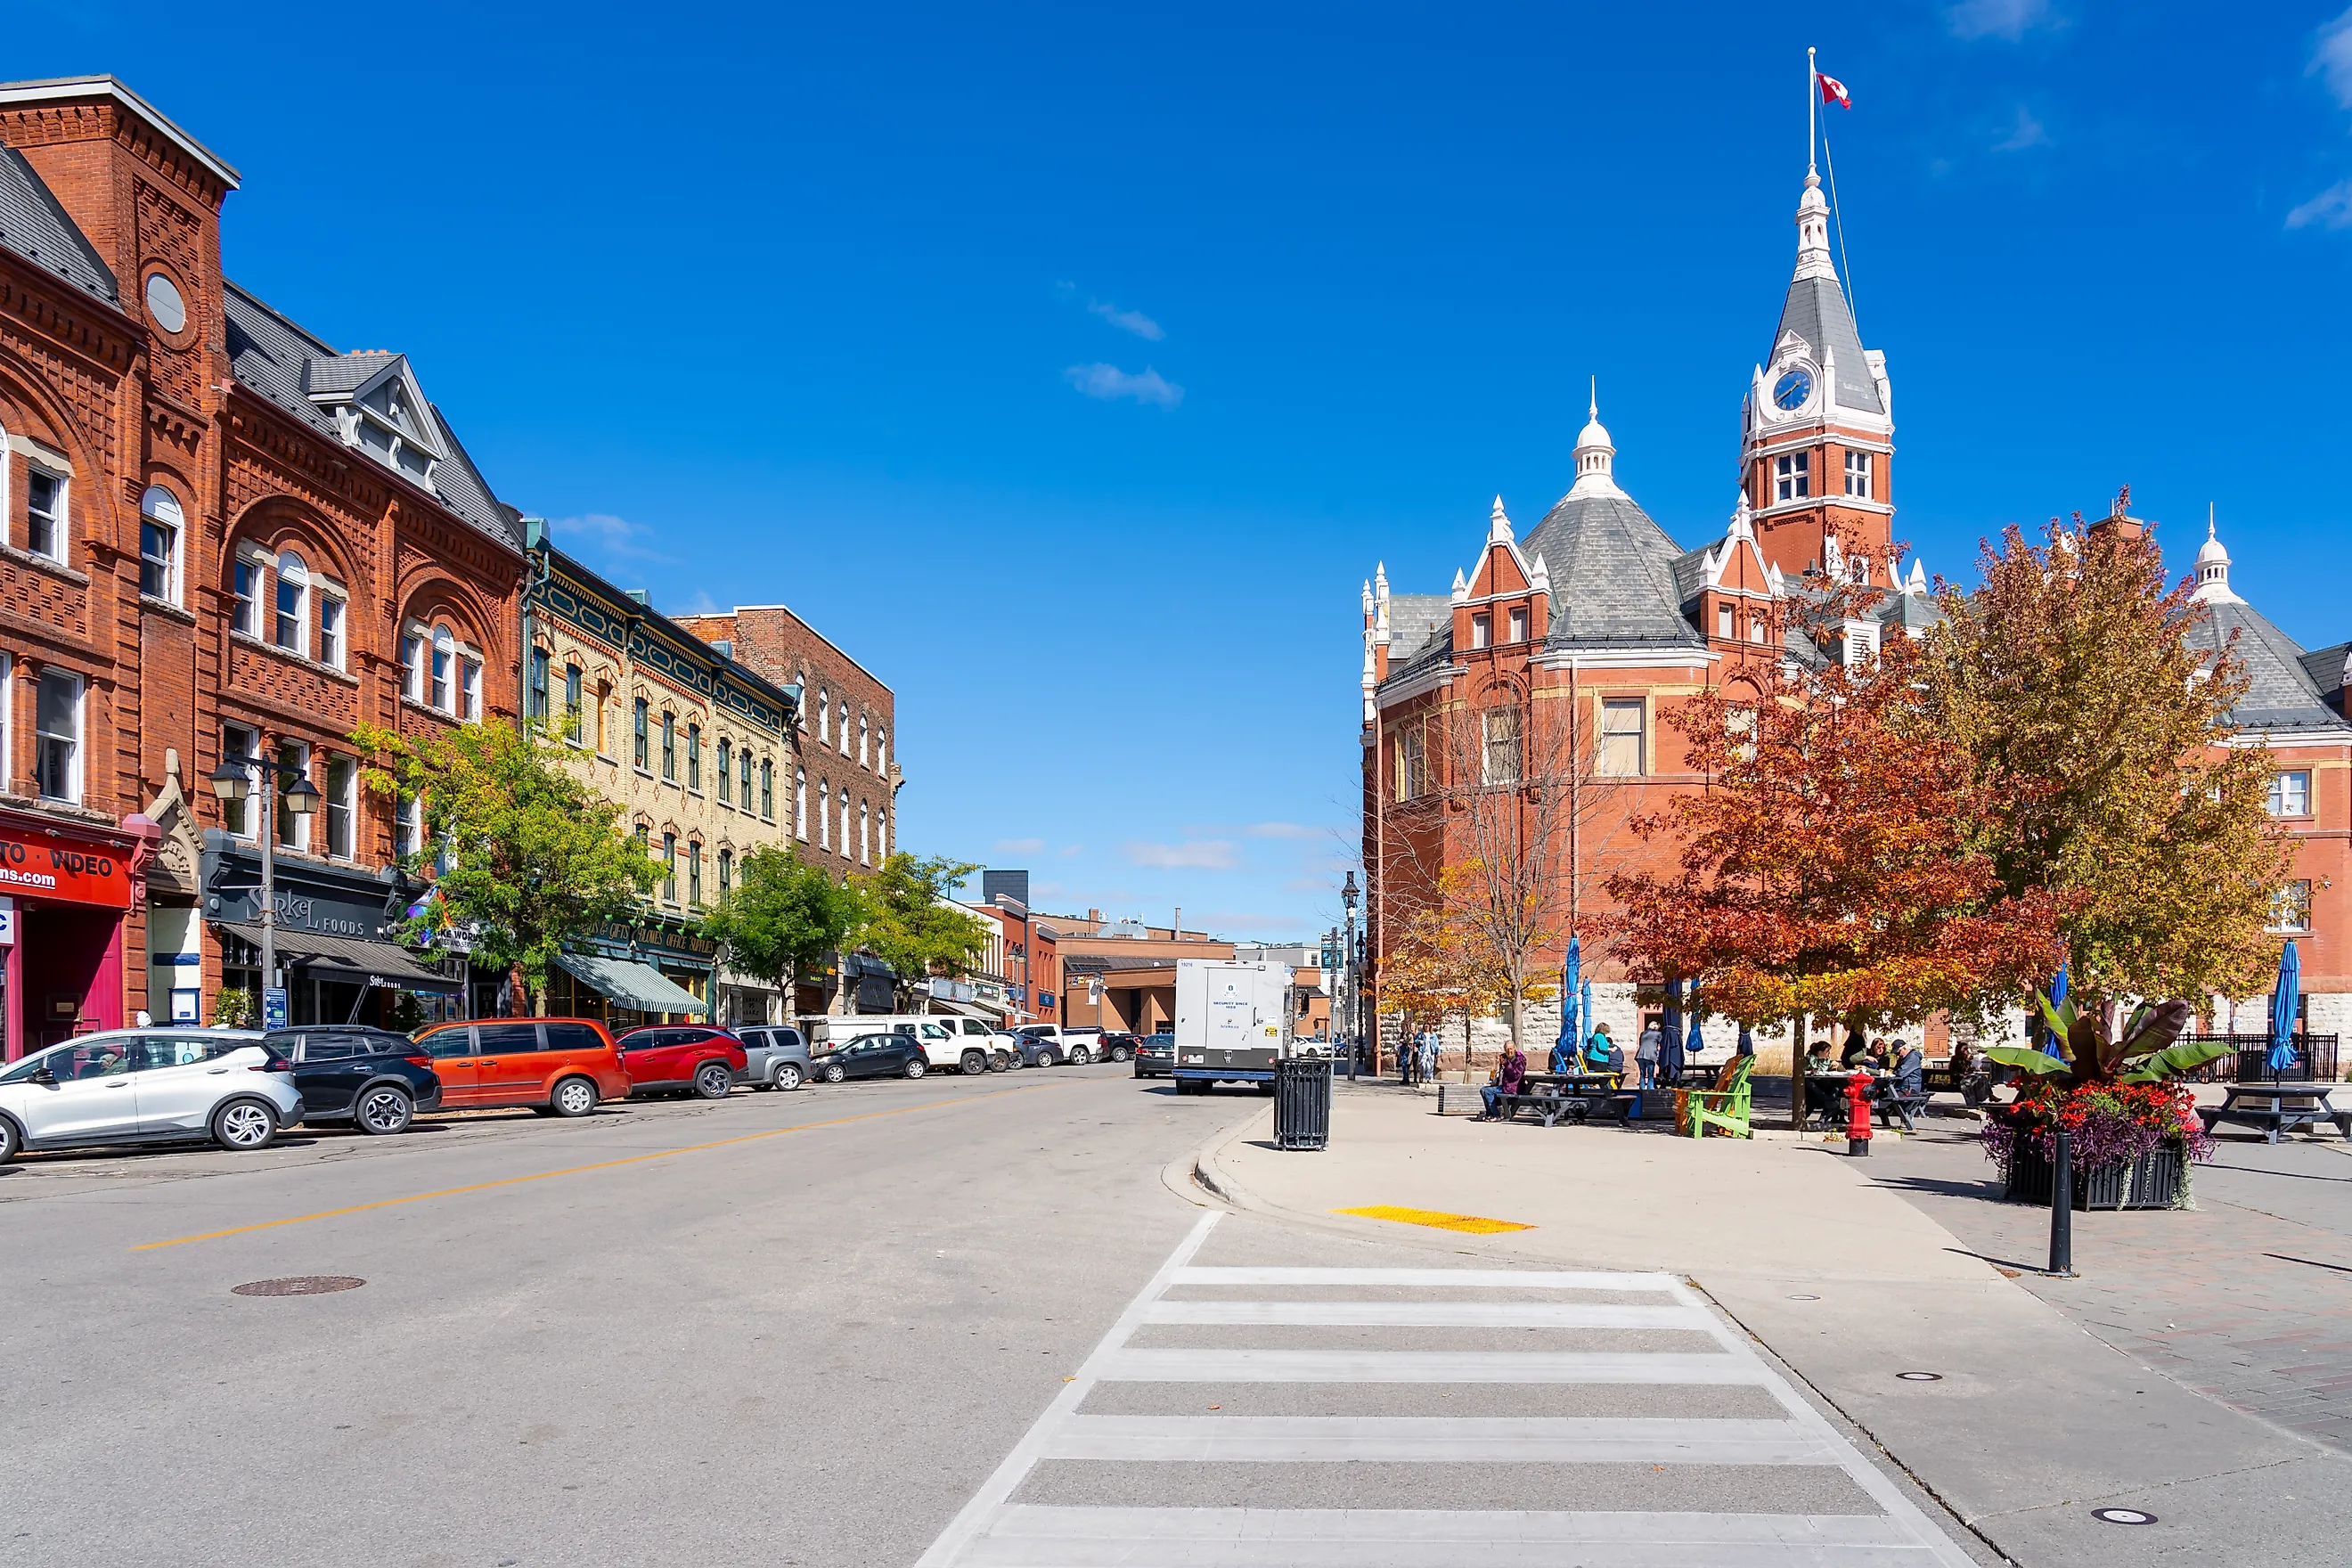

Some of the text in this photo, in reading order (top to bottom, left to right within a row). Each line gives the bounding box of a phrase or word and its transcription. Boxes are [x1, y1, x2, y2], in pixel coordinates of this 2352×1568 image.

[50, 849, 112, 877] VIDEO
[323, 918, 364, 935] FOODS
[608, 922, 631, 940] GIFTS
[666, 933, 687, 951] OFFICE
